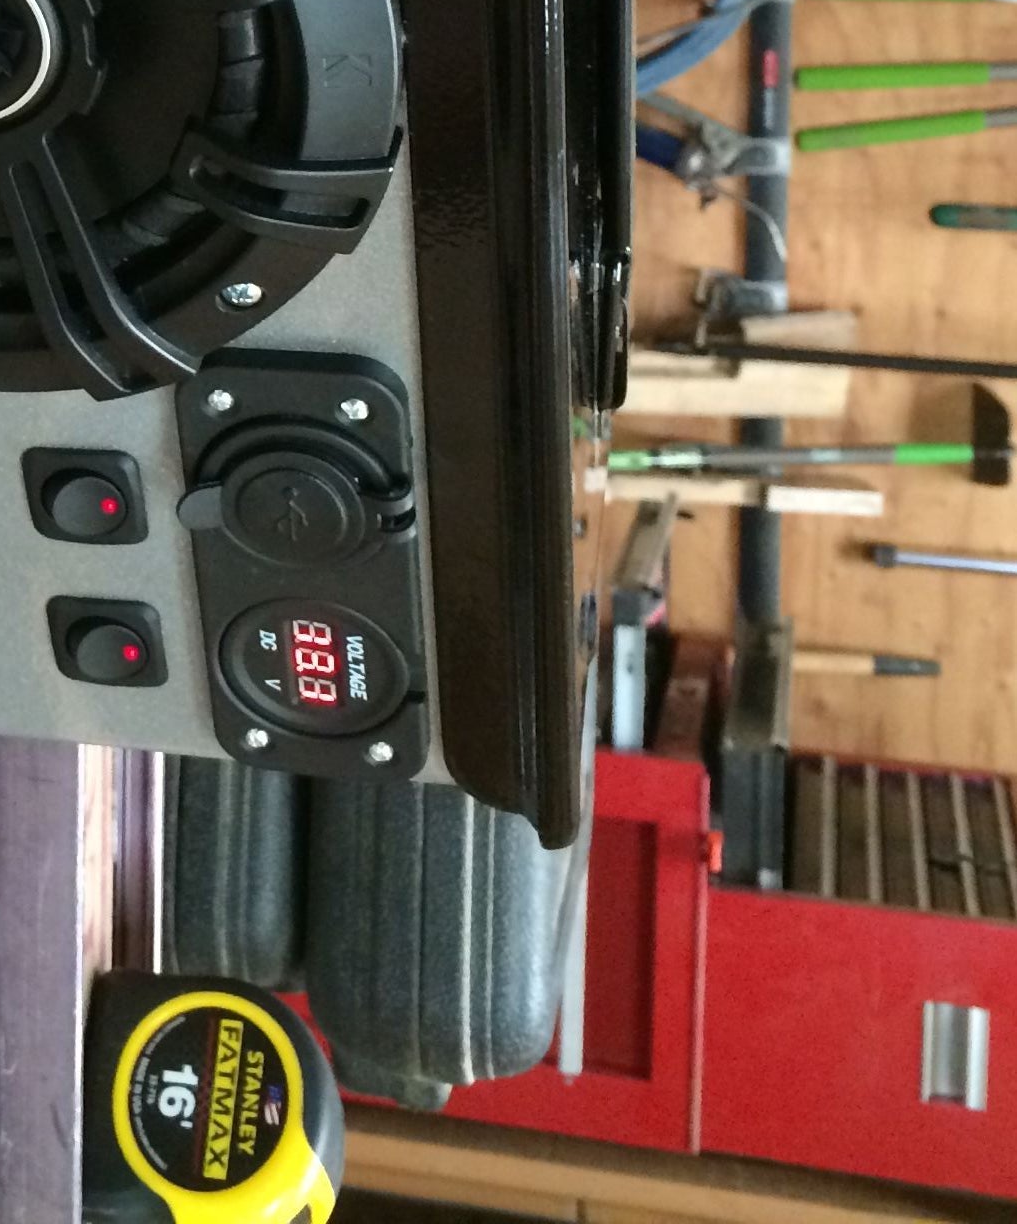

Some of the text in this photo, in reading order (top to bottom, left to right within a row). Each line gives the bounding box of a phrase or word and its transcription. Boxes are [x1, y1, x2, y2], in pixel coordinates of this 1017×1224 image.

[259, 629, 282, 692] DC V
[345, 635, 369, 702] VOLTAGE
[157, 1063, 200, 1130] 16'
[207, 1025, 241, 1168] FATMAX
[237, 1050, 265, 1157] STANLEY
